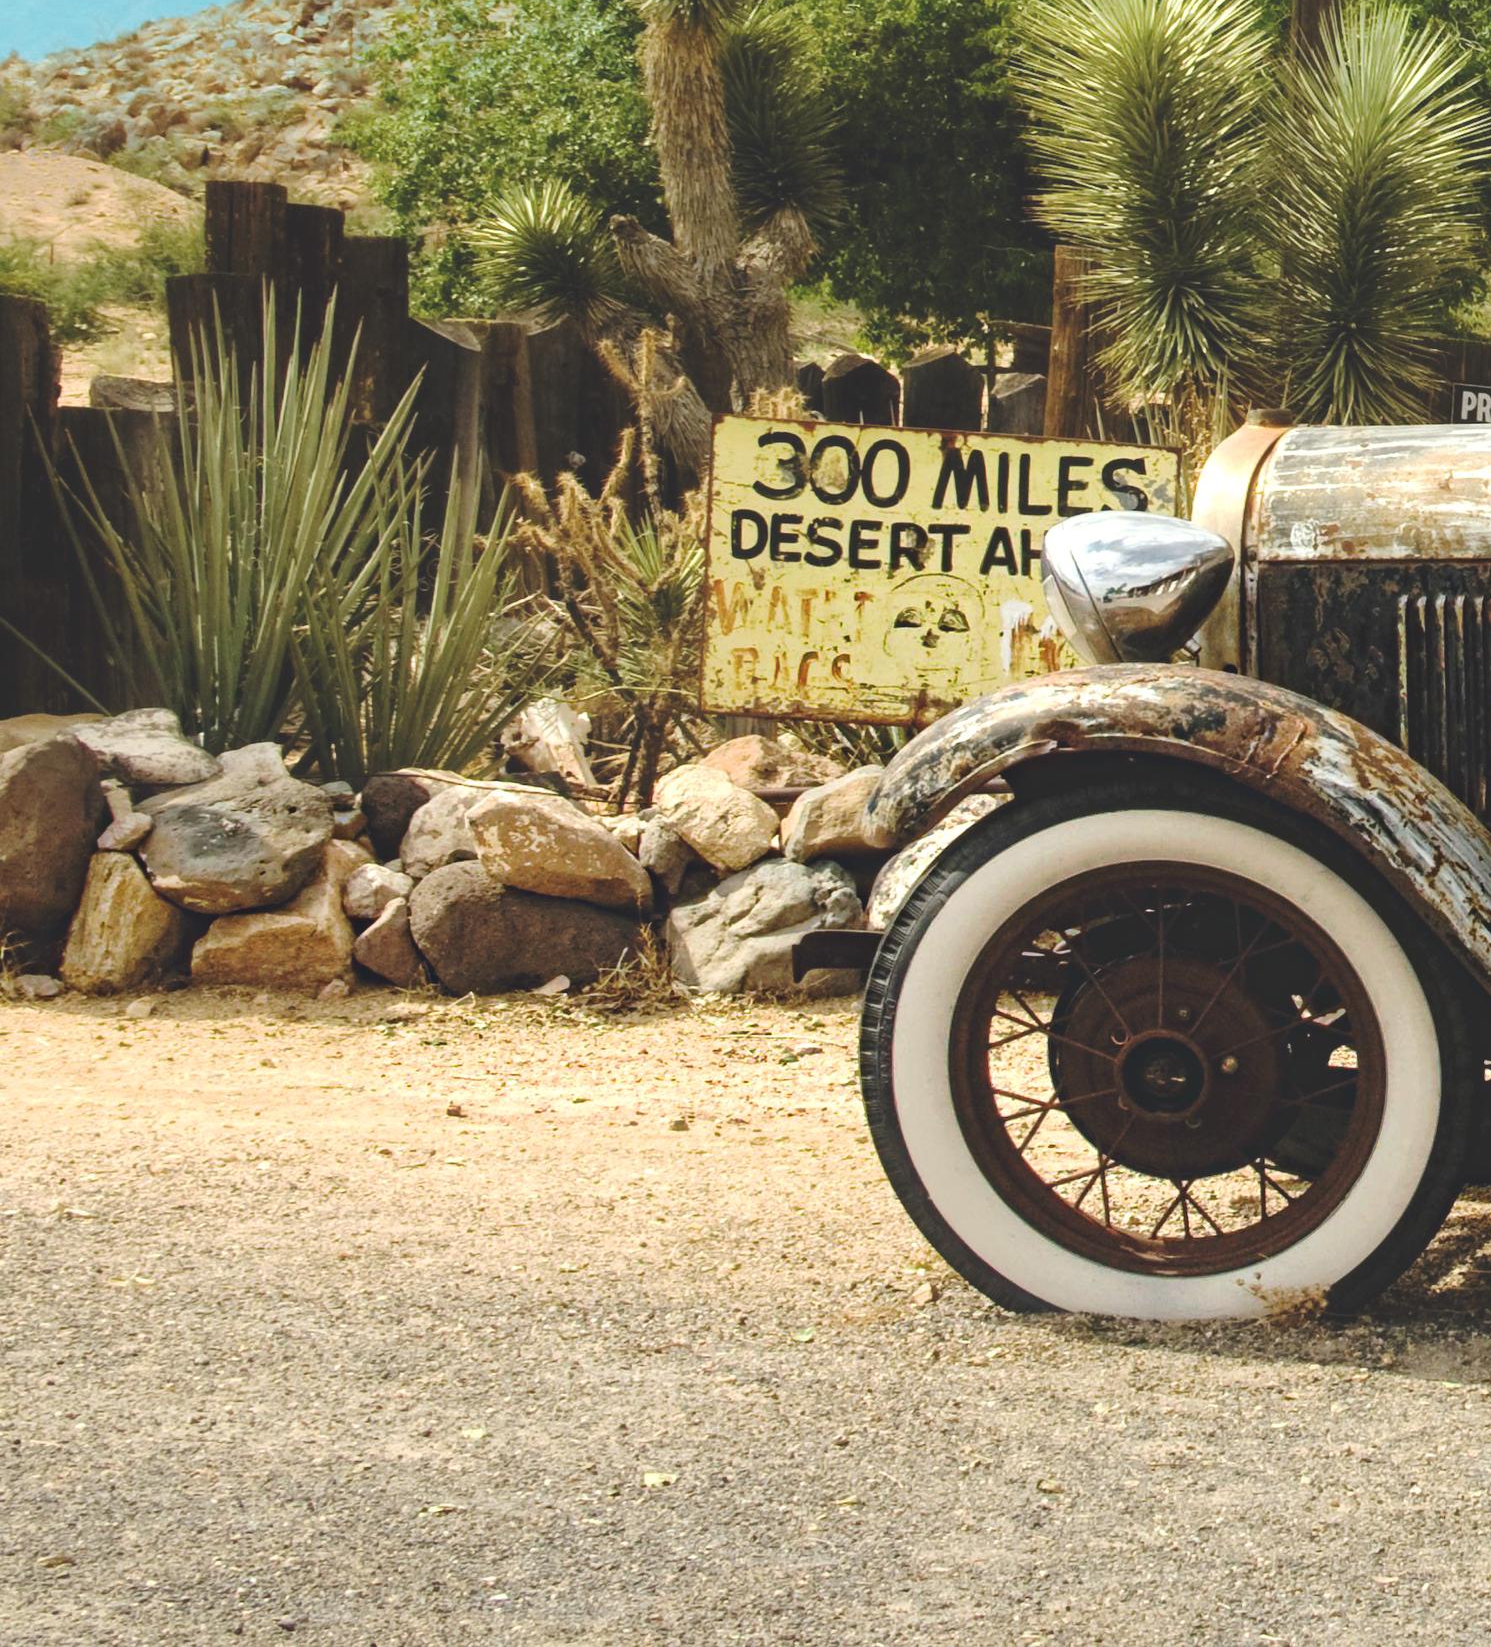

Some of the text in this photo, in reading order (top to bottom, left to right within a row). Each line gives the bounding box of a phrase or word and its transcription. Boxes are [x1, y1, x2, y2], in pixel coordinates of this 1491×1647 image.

[752, 431, 1148, 517] 300 MILES
[731, 509, 971, 572] DESERT
